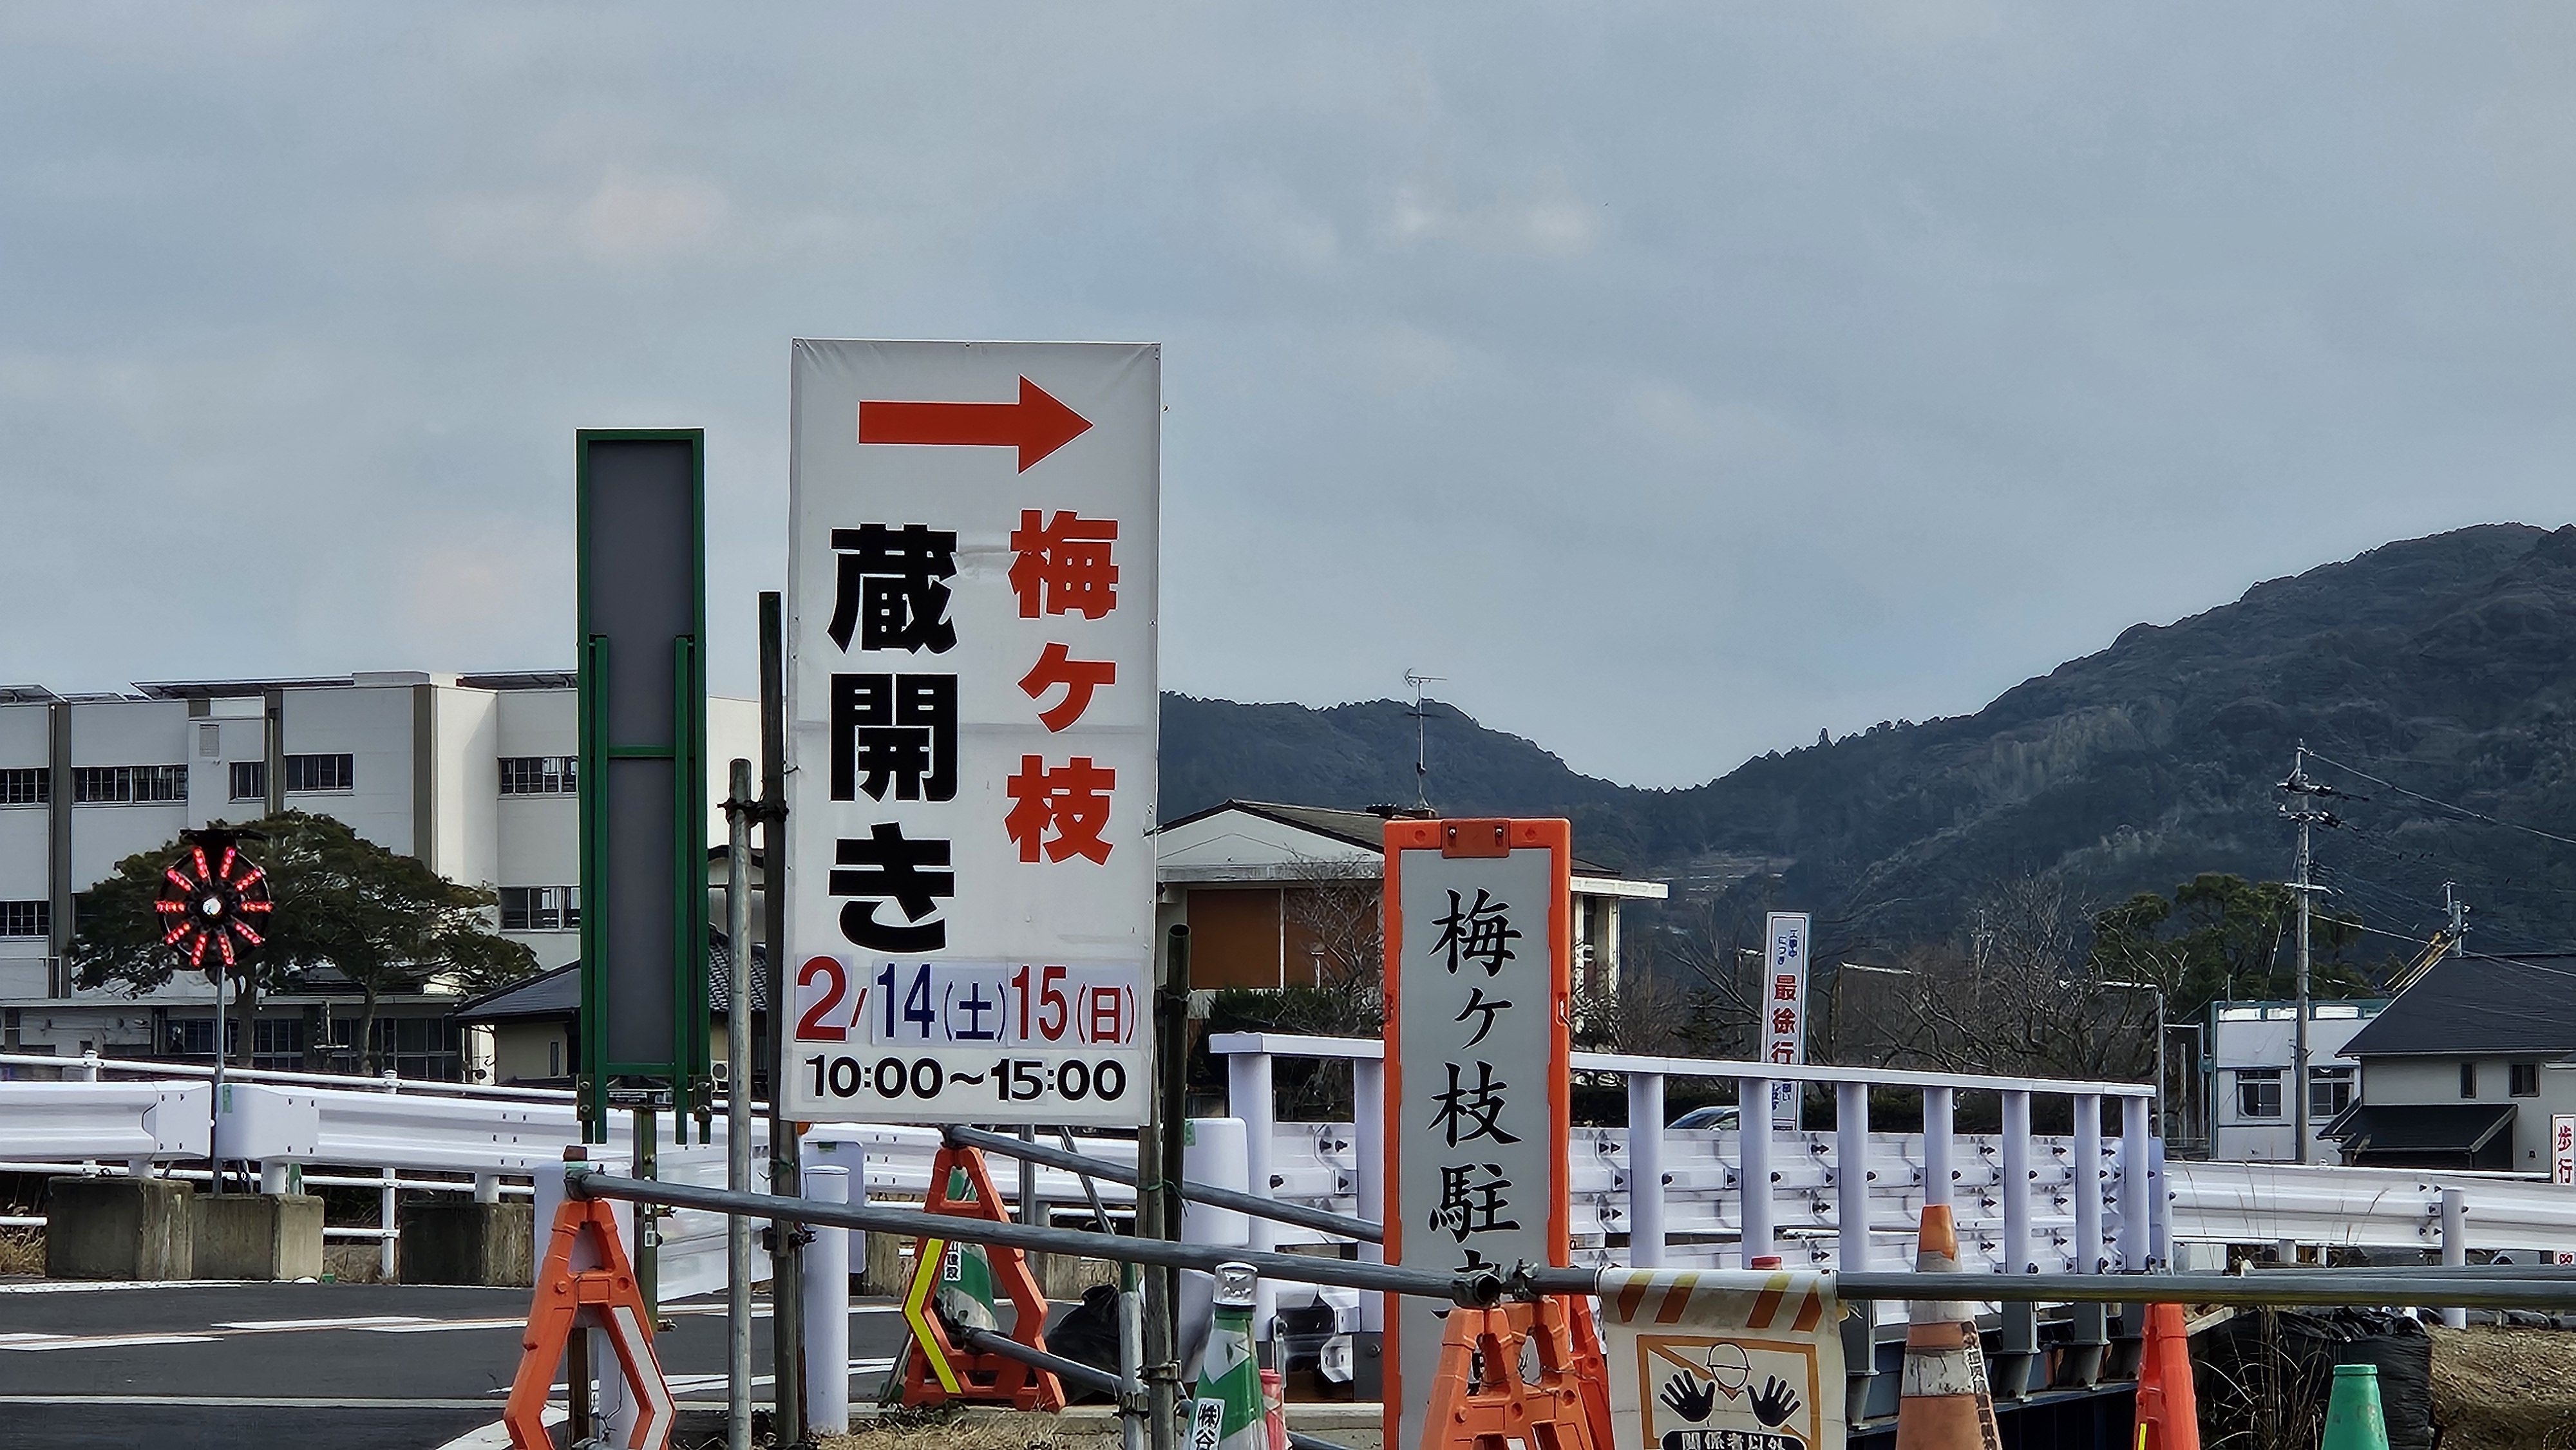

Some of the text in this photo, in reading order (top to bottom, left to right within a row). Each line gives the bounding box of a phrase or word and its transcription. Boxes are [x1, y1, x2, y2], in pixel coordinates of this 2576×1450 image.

[828, 523, 958, 952] 蔵開き
[1771, 974, 1797, 1064] 最徐行
